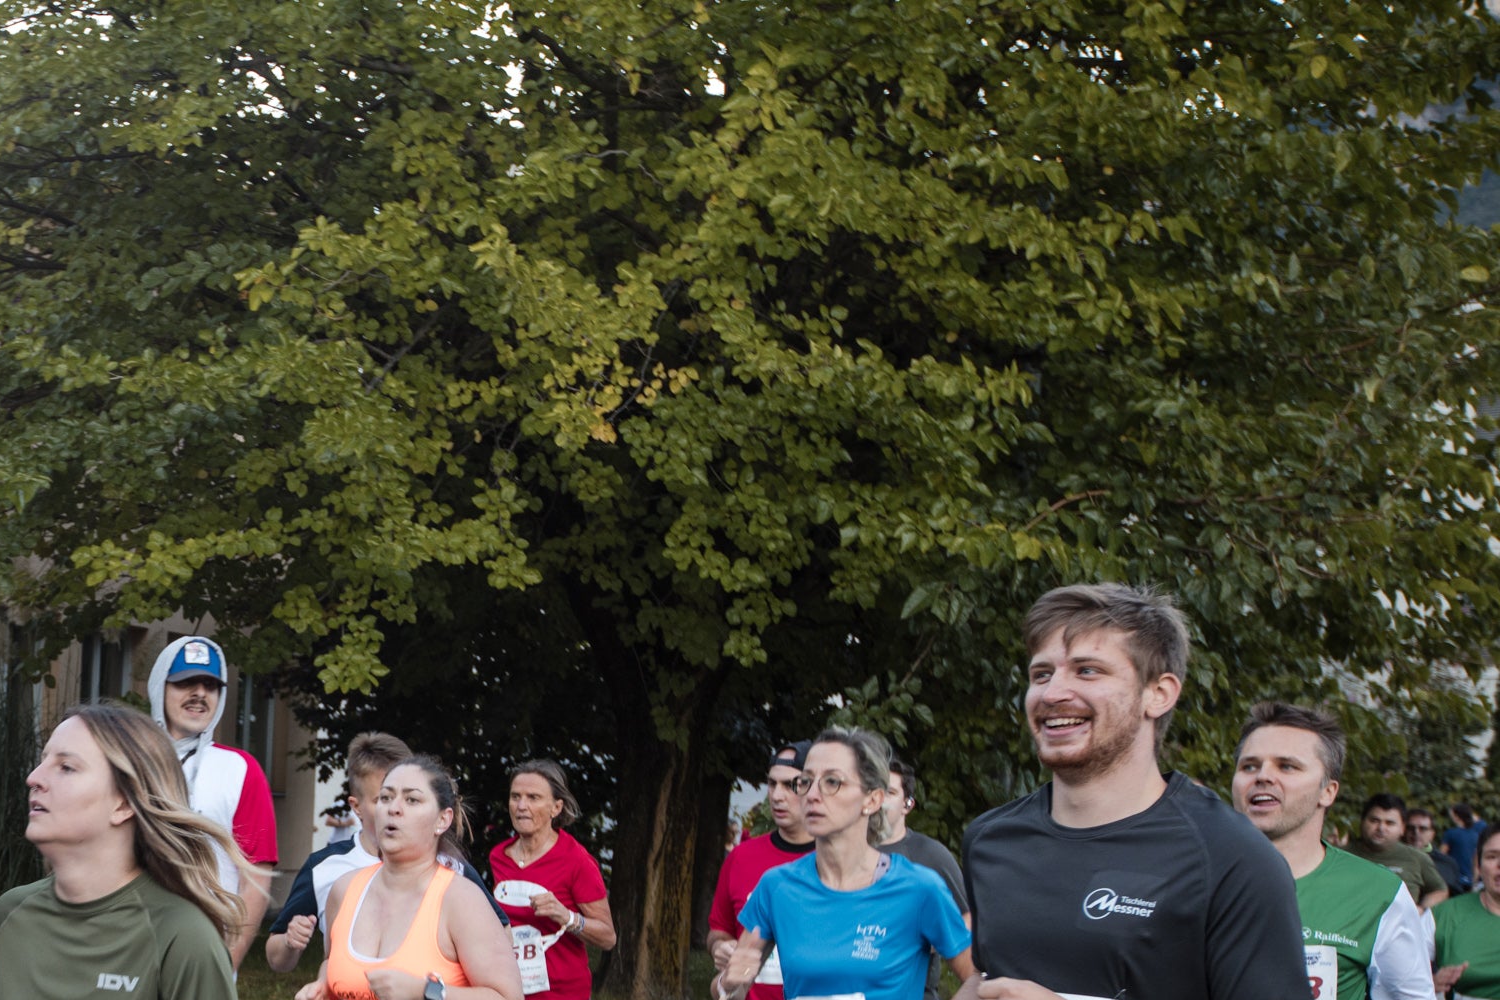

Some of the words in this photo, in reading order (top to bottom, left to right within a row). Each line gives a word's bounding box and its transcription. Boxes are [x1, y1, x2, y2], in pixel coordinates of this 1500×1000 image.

[1086, 893, 1155, 918] Messner
[1121, 895, 1157, 908] Tischlerei
[856, 922, 887, 938] HTM
[1314, 930, 1359, 948] Raiffeisen
[96, 972, 140, 993] IDV
